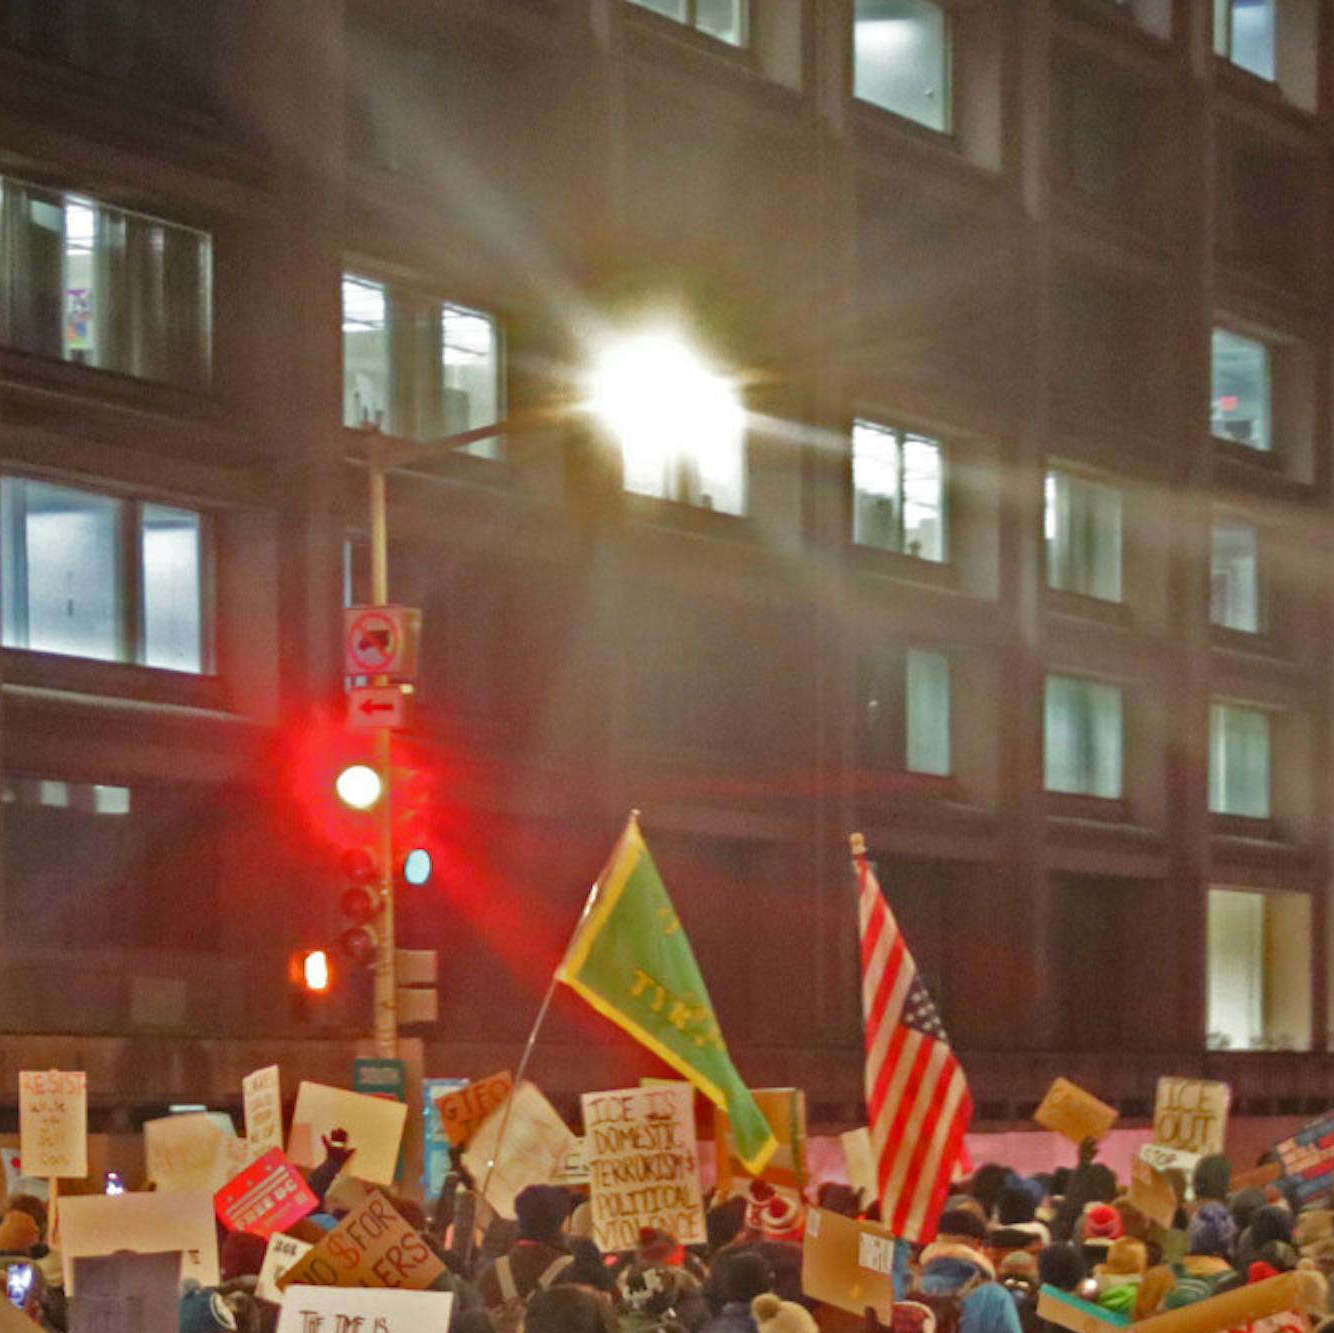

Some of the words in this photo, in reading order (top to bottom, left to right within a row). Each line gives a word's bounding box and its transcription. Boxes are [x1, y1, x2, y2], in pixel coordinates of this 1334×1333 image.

[588, 1095, 636, 1126] ICE
[594, 1122, 687, 1155] DOMESTIC
[1159, 1114, 1217, 1152] OUT
[596, 1184, 700, 1219] POLITICAL
